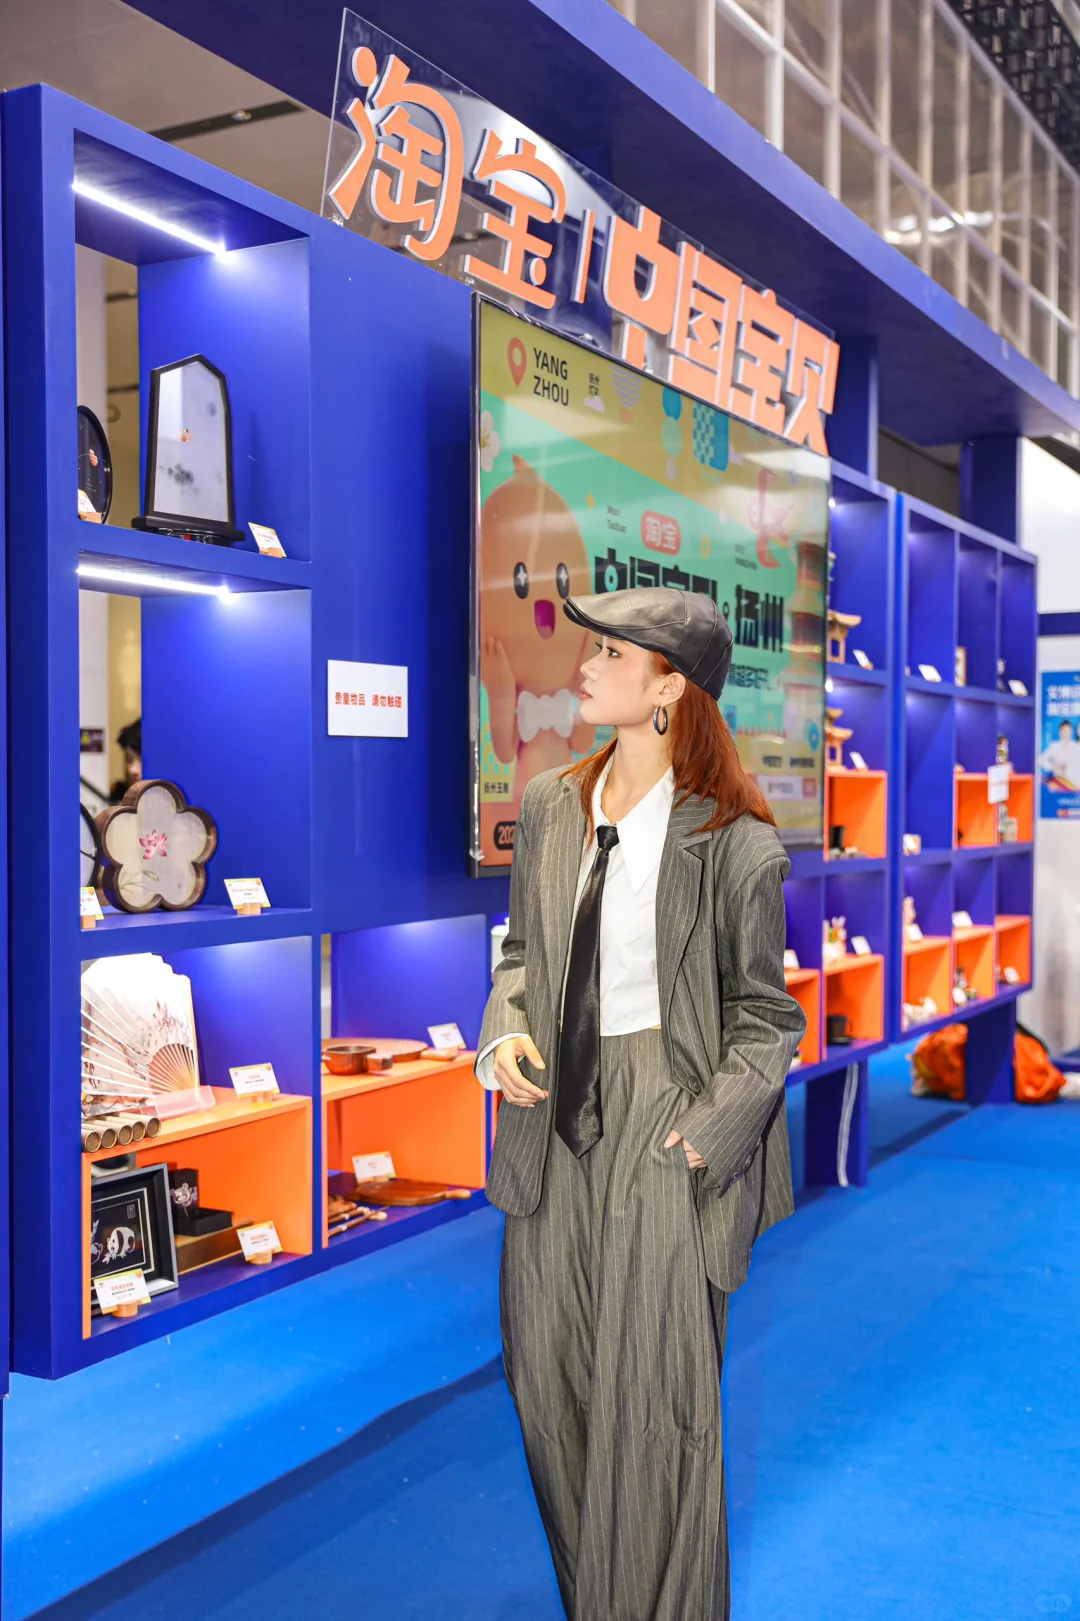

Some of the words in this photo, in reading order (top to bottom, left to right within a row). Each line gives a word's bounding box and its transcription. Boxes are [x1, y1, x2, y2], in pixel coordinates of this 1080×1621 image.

[328, 46, 566, 309] 淘宝
[533, 347, 569, 380] YANG
[533, 375, 569, 406] ZHOU
[645, 517, 677, 550] 淘宝
[335, 692, 366, 706] 贵重物品
[372, 694, 403, 708] 请勿触碰
